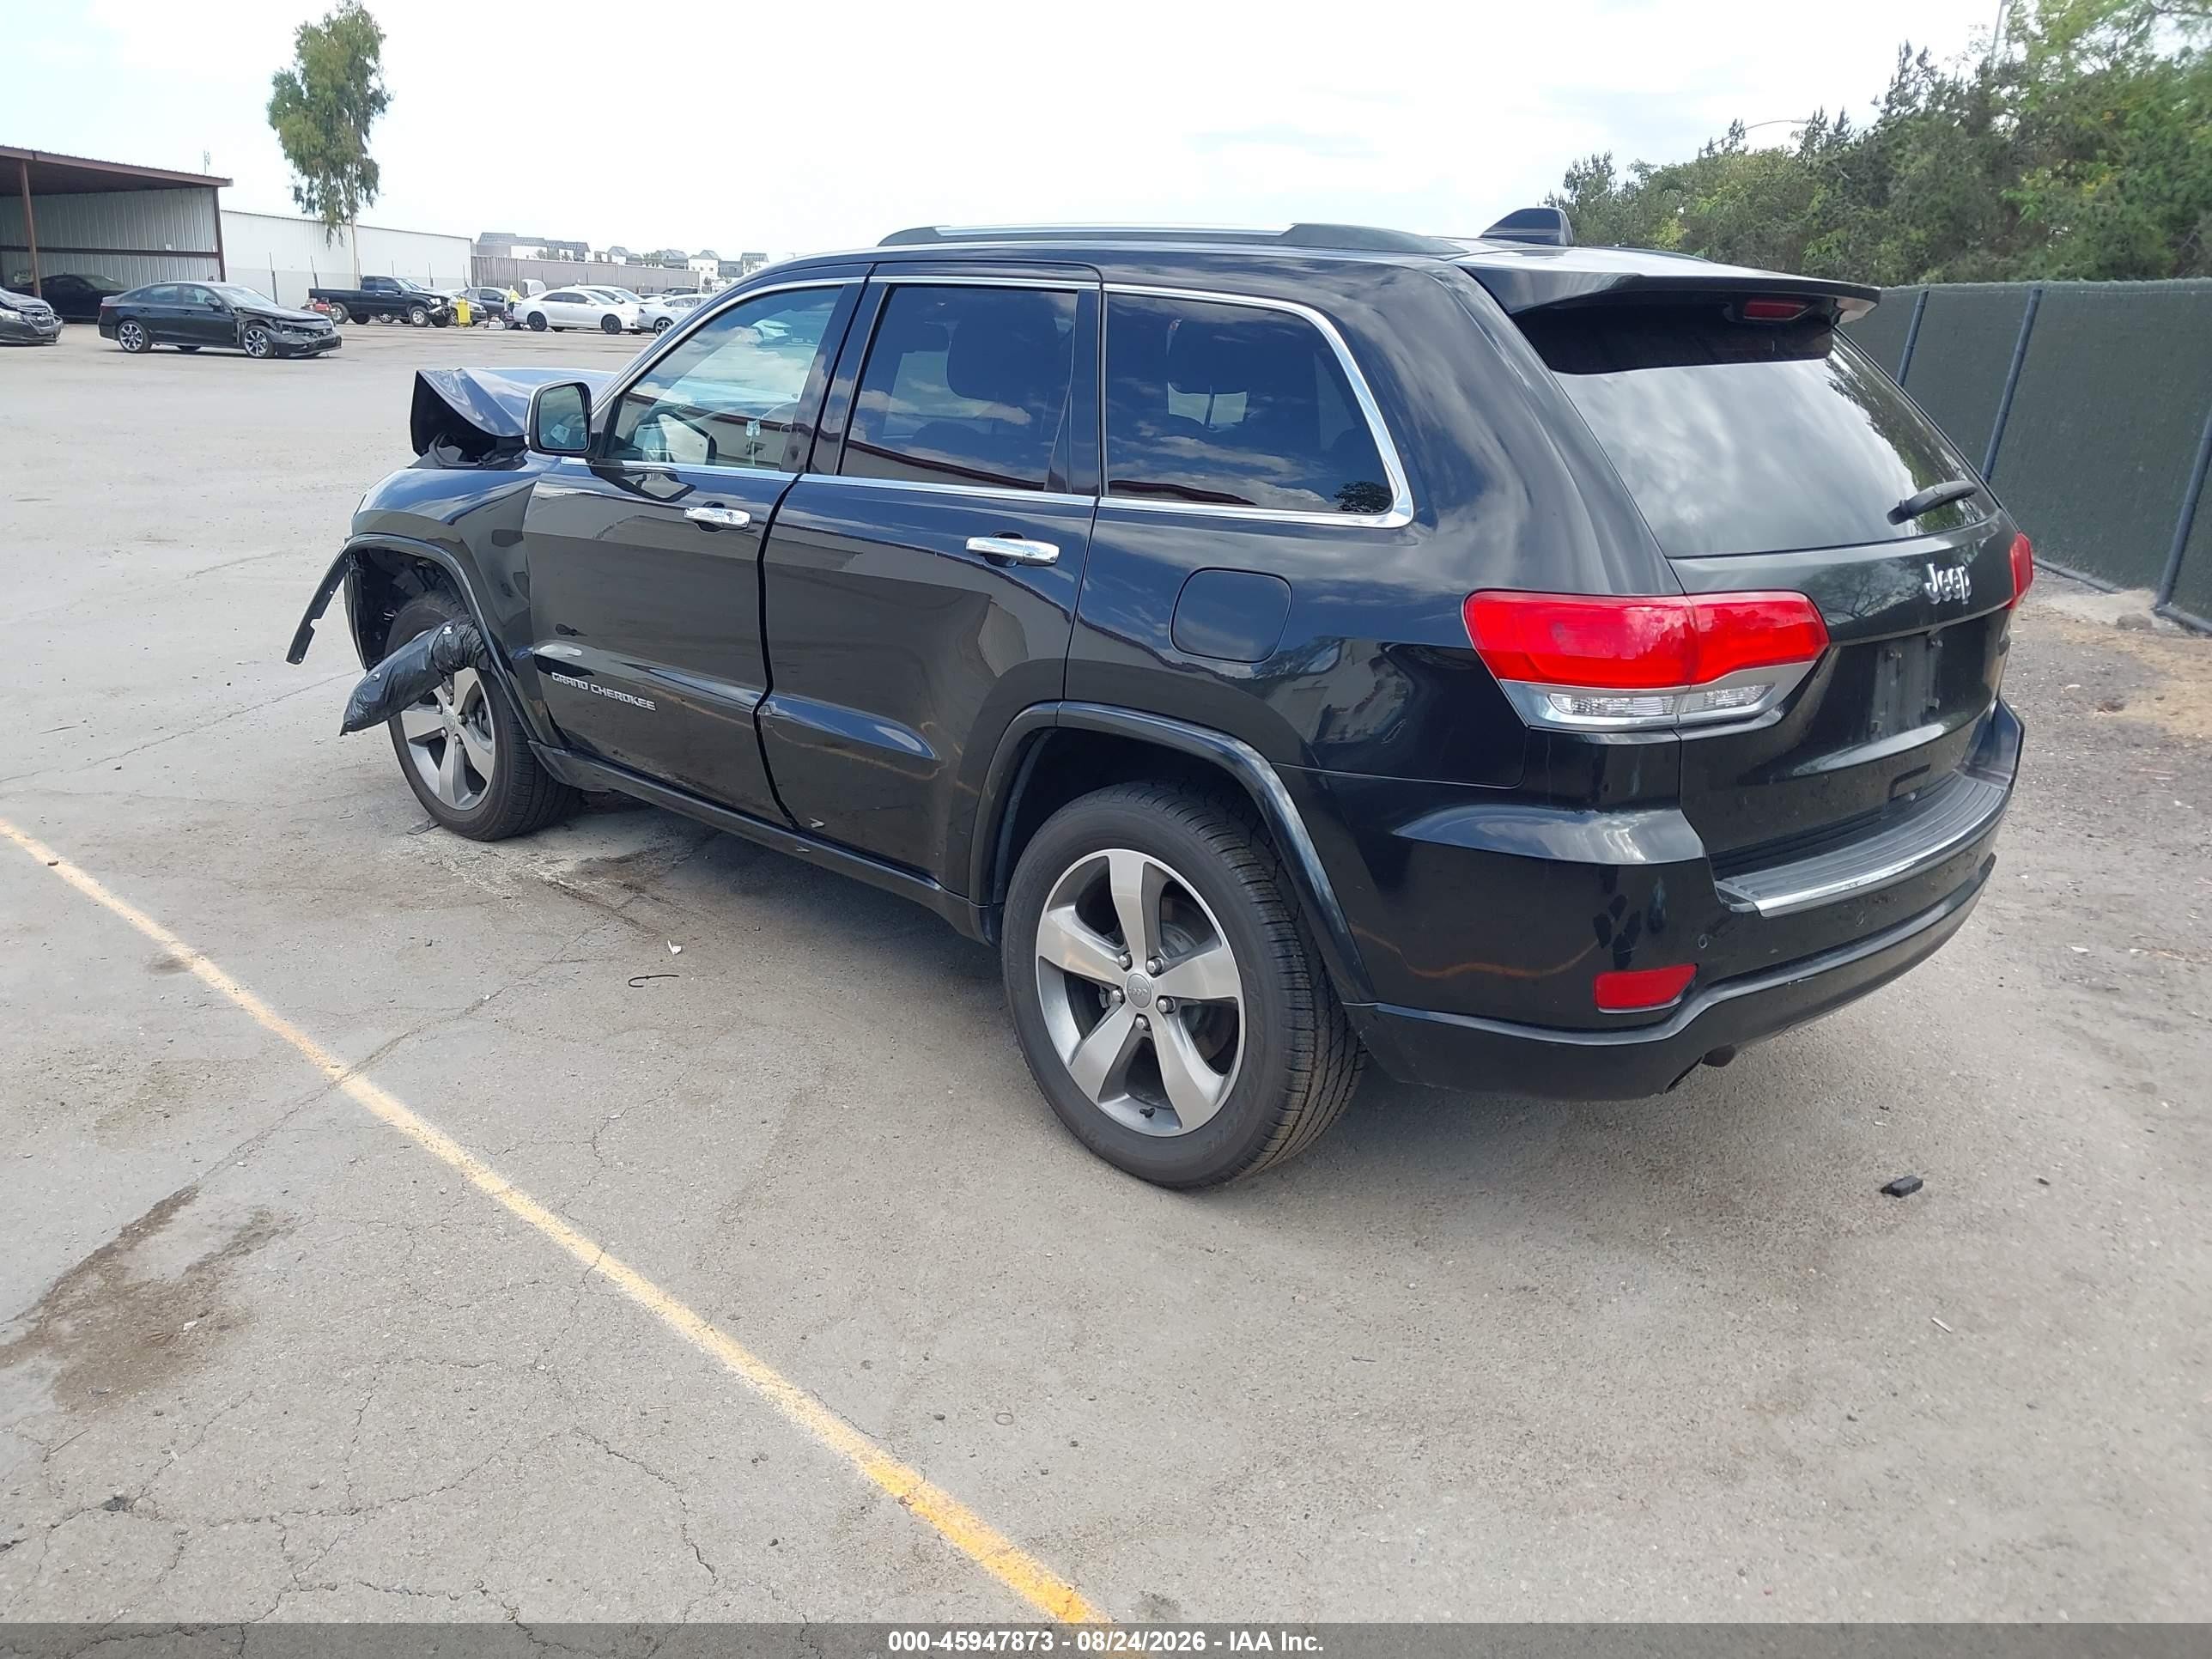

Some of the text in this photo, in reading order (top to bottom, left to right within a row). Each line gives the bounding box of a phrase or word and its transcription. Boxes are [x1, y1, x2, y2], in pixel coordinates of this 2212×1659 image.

[1923, 562, 1972, 605] Jeep
[550, 672, 656, 711] GRAND CHEROKEE
